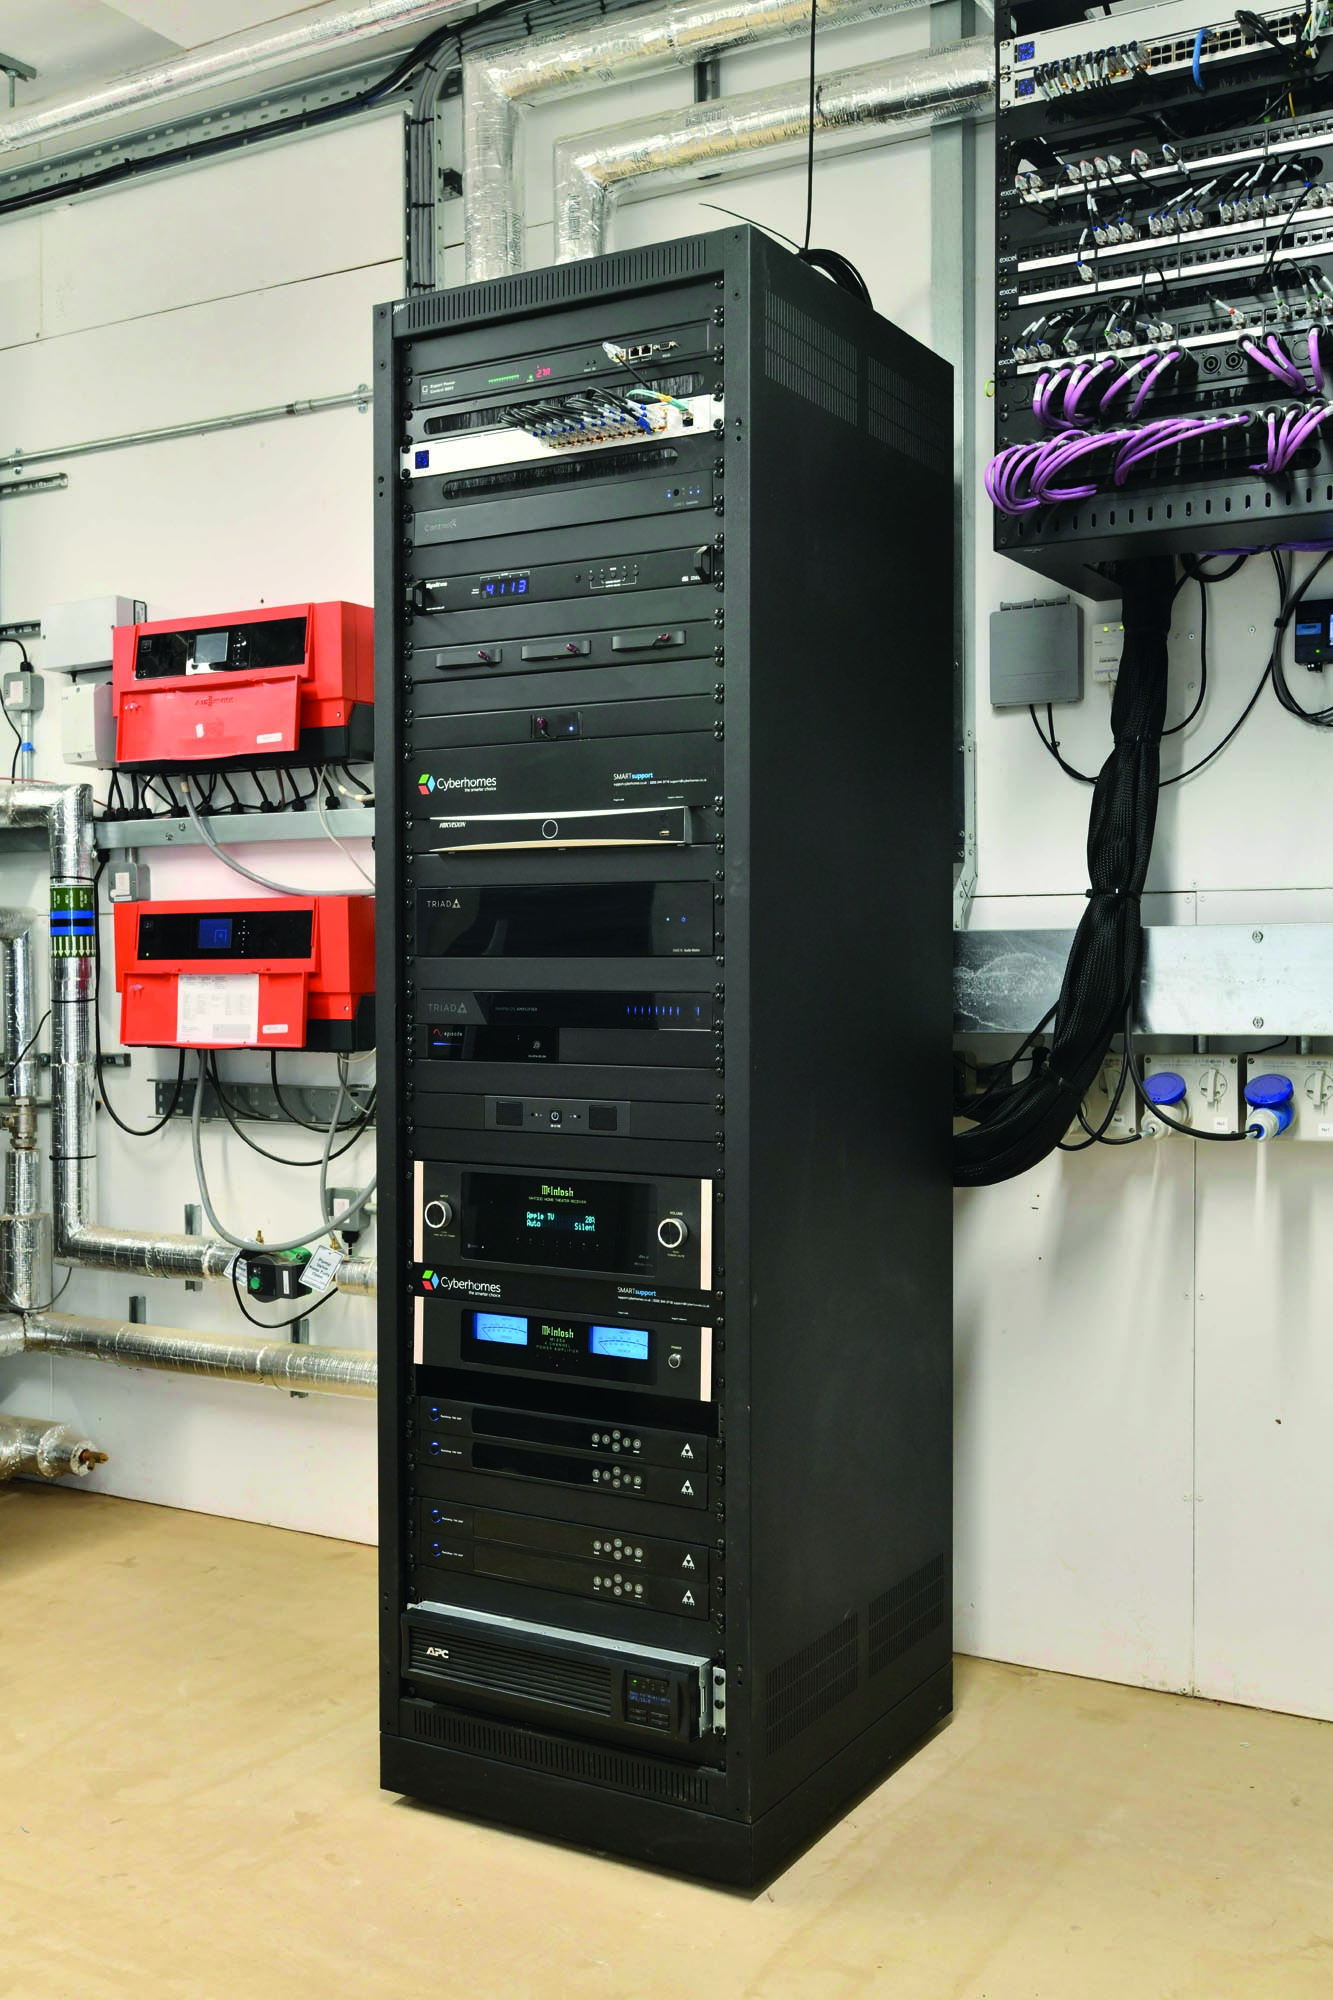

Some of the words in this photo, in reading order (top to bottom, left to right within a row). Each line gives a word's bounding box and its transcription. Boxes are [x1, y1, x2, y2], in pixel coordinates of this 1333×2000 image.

[1000, 254, 1018, 263] excel
[1000, 287, 1018, 296] excel
[486, 579, 527, 595] 4113
[613, 772, 653, 781] SMARTsupport
[436, 776, 497, 791] Cyberhomes
[426, 900, 452, 908] TRIAD
[427, 1003, 457, 1013] TRIAD
[541, 1184, 574, 1197] McIntosh
[526, 1211, 544, 1220] Apple
[547, 1212, 555, 1221] TV
[526, 1219, 541, 1227] Auto
[574, 1222, 596, 1232] Silent
[440, 1276, 501, 1293] Cyberhomes
[617, 1286, 657, 1296] SMARTsupport
[541, 1325, 574, 1338] McIntosh
[426, 1646, 449, 1659] APC
